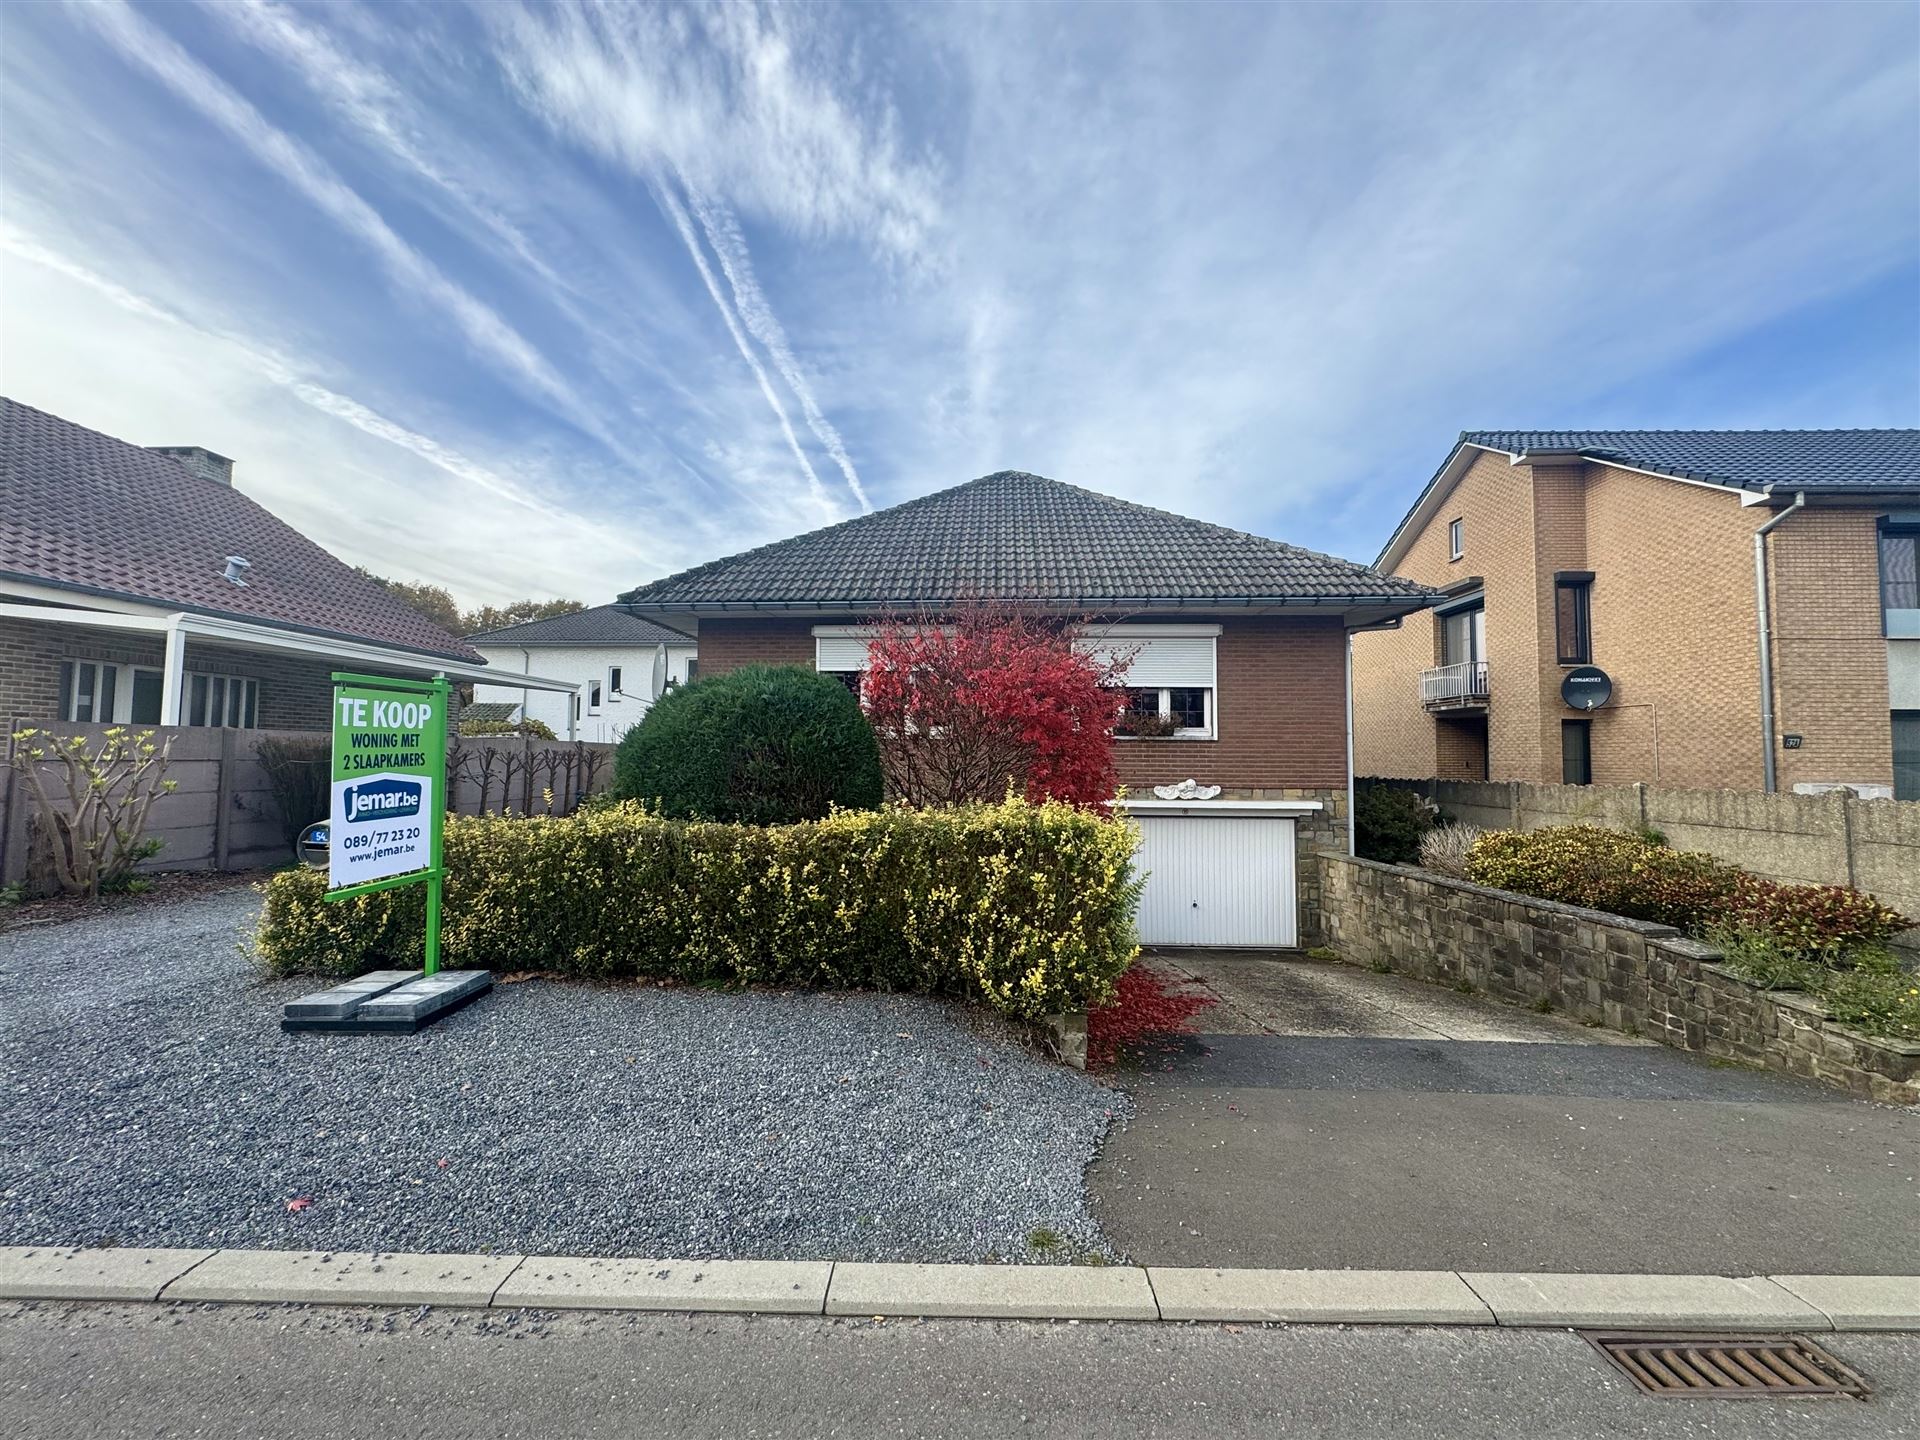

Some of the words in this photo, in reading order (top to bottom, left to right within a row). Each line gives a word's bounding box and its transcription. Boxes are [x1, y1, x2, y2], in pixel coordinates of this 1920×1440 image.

[339, 698, 367, 727] TE
[373, 700, 432, 729] KOOP
[351, 733, 398, 748] WONING
[400, 733, 420, 748] MET
[343, 754, 350, 770] 2
[353, 752, 425, 770] SLAAPKAMERS
[348, 785, 418, 820] jemar.be
[391, 829, 404, 841] 23
[406, 827, 420, 840] 20
[350, 844, 415, 863] www.jemar.be
